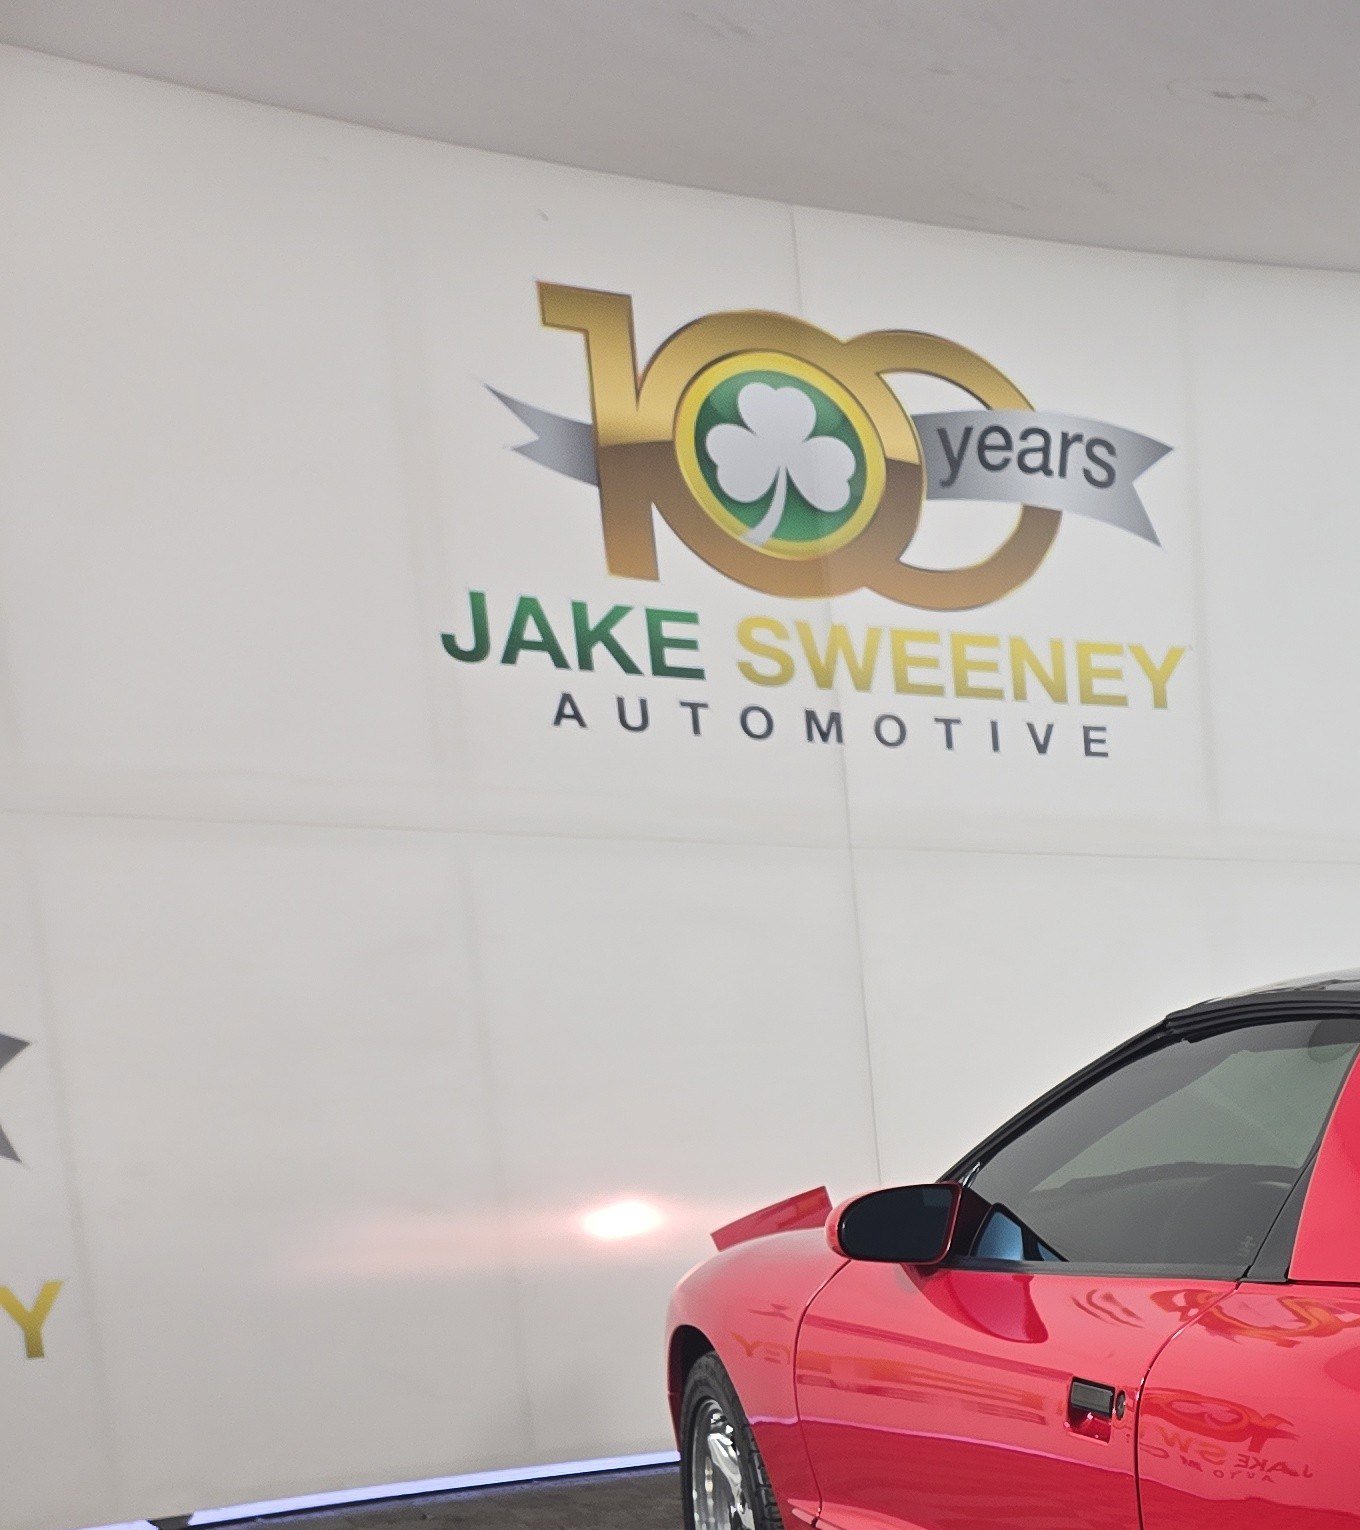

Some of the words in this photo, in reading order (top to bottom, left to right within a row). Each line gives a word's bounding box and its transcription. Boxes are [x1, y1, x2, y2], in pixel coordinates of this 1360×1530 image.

[936, 423, 1118, 489] years
[440, 589, 707, 681] JAKE
[735, 616, 1186, 710] SWEENEY
[552, 691, 1110, 758] AUTOMOTIVE
